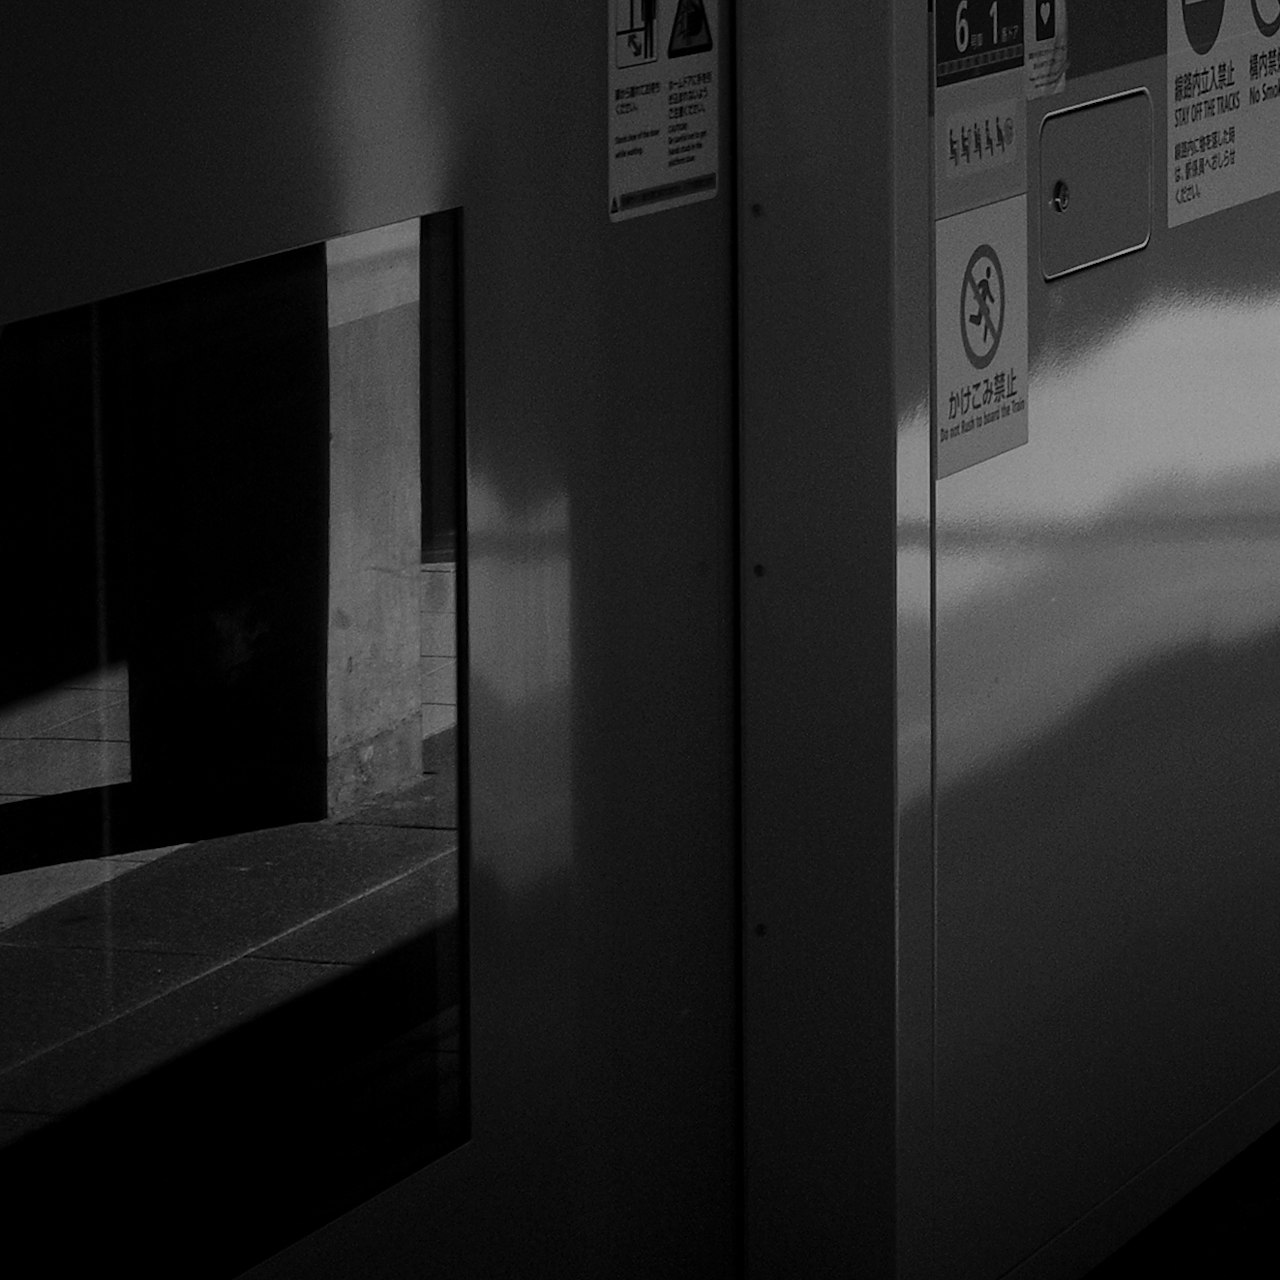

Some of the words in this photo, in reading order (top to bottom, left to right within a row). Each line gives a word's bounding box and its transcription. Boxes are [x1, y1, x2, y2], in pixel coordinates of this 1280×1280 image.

[1174, 59, 1236, 102] 線路内立入禁止
[1249, 86, 1261, 106] No
[1174, 104, 1190, 128] STAY
[1191, 100, 1203, 123] OFF
[948, 367, 1018, 420] かけこみ禁止
